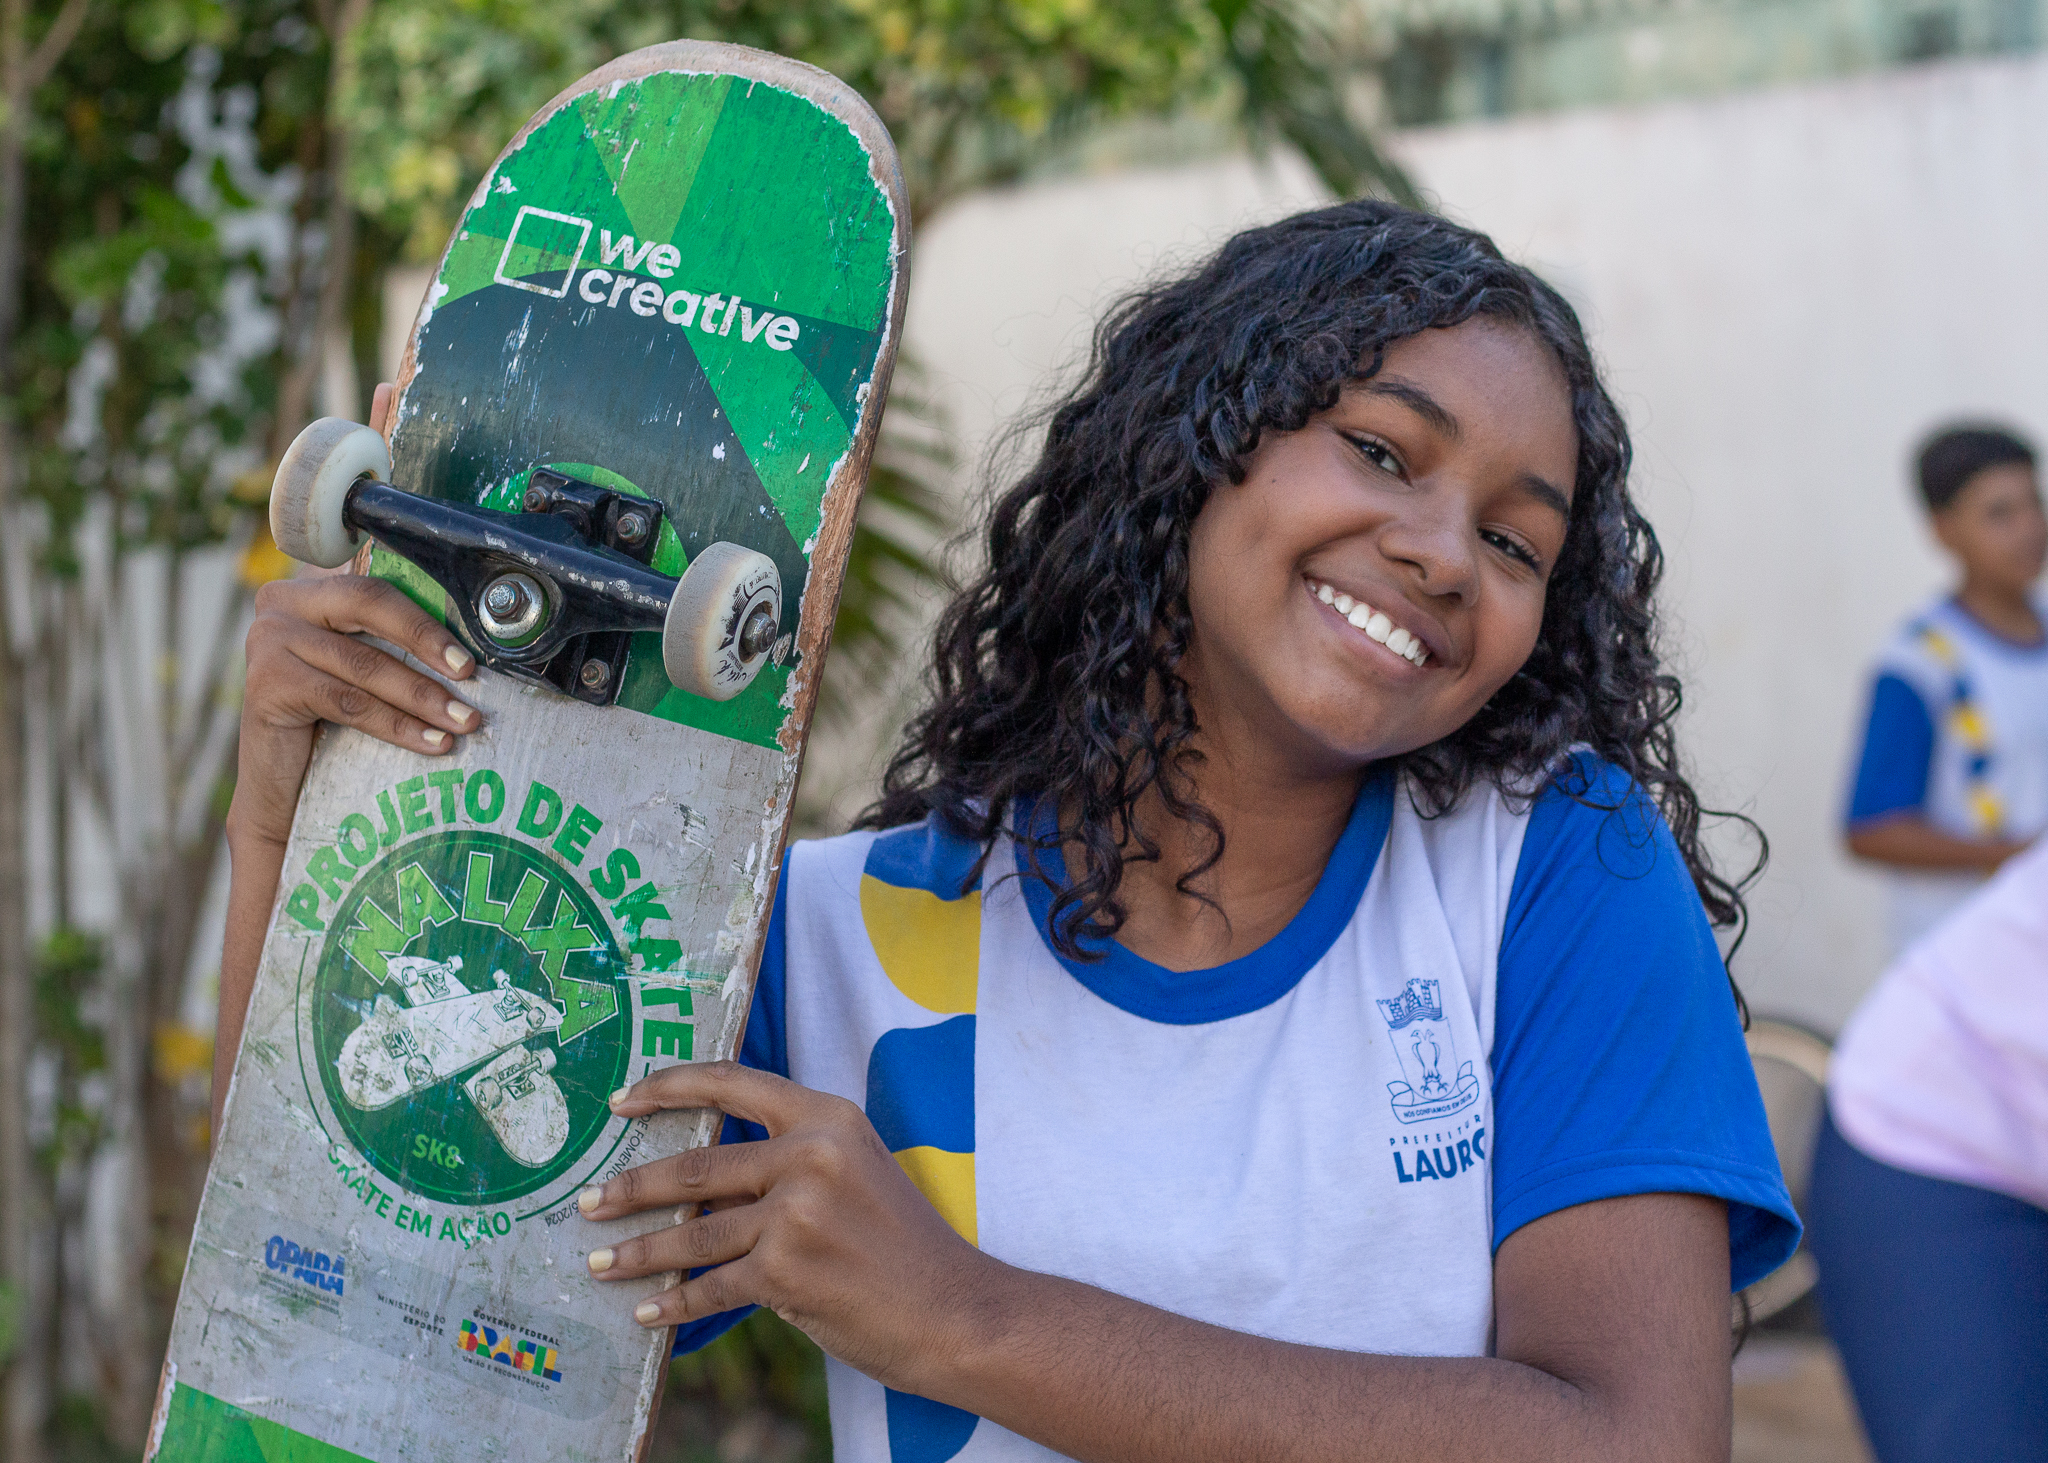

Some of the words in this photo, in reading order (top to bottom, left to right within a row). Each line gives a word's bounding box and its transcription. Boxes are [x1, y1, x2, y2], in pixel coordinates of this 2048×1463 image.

[600, 229, 681, 278] we
[578, 269, 800, 352] creative
[285, 768, 506, 931] PROJETO
[516, 780, 604, 867] DE
[589, 848, 695, 1061] SKATE
[338, 861, 459, 987] NA
[461, 851, 620, 1047] LIXA
[412, 1134, 461, 1169] SK8
[394, 1204, 433, 1238] EM
[438, 1211, 512, 1250] AÇÃO
[403, 1316, 444, 1336] ESPORTE
[457, 1318, 562, 1383] BRASIL
[473, 1310, 516, 1331] GOVERNO
[519, 1326, 561, 1346] FEDERAL
